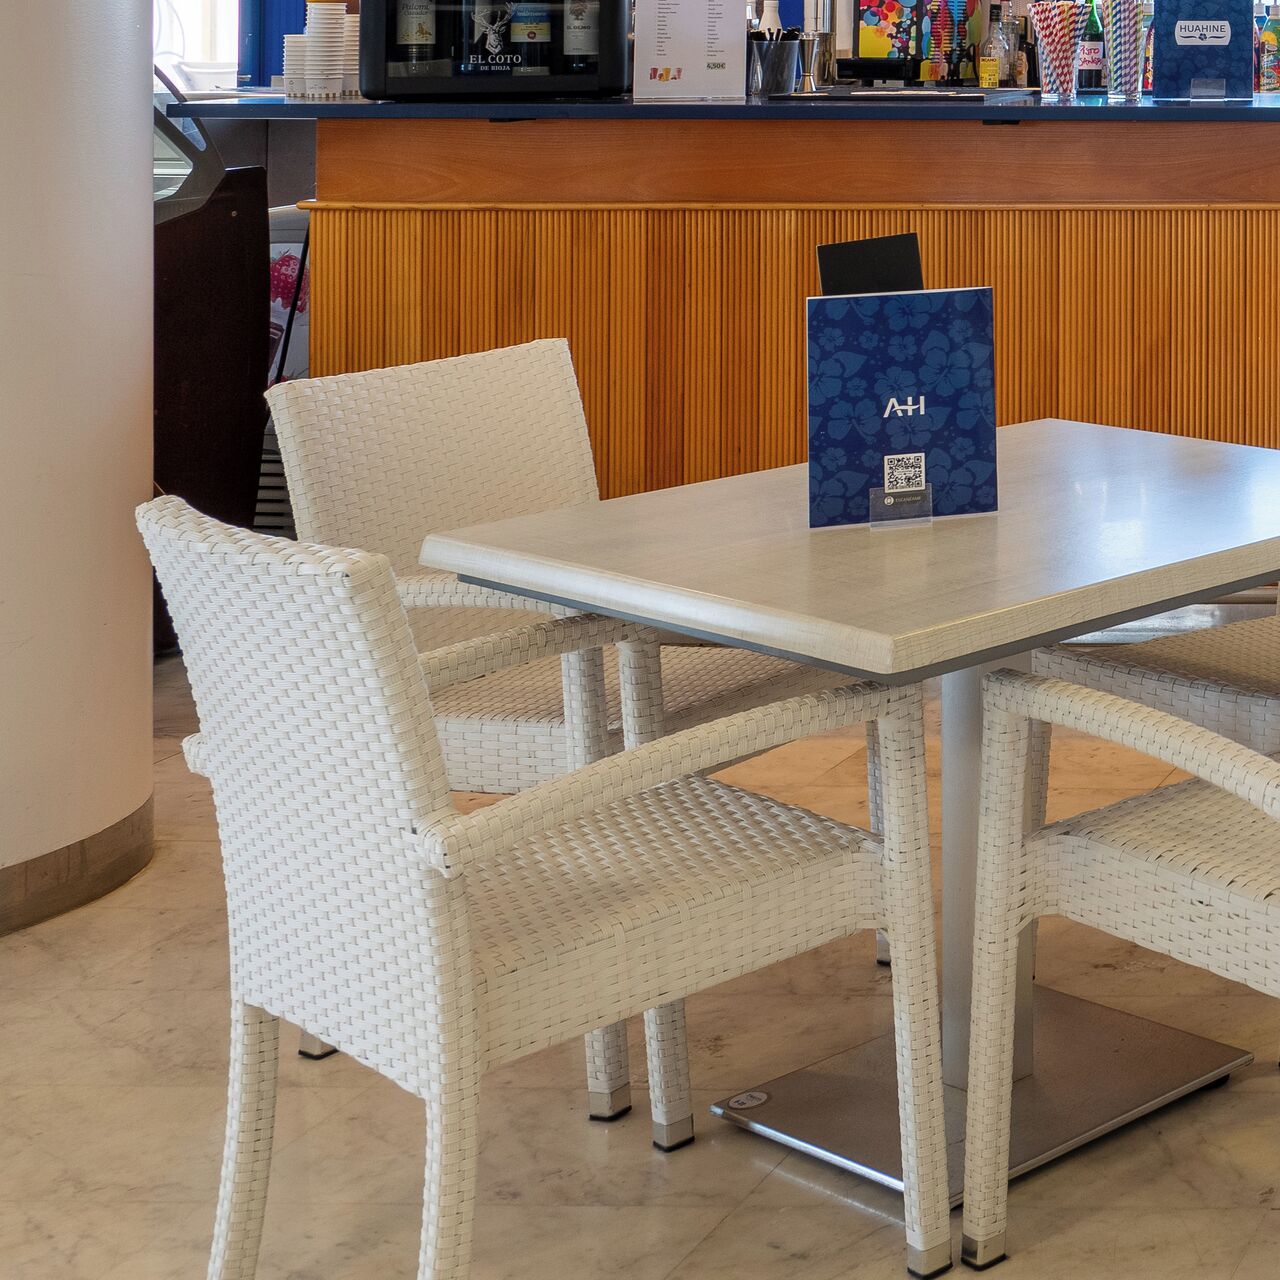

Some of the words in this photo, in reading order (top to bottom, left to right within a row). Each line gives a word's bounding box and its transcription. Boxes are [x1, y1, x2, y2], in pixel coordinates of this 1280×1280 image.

[1179, 24, 1227, 34] HUAHINE
[469, 54, 486, 64] EL
[488, 54, 523, 64] COTO
[706, 62, 726, 70] 4,50€
